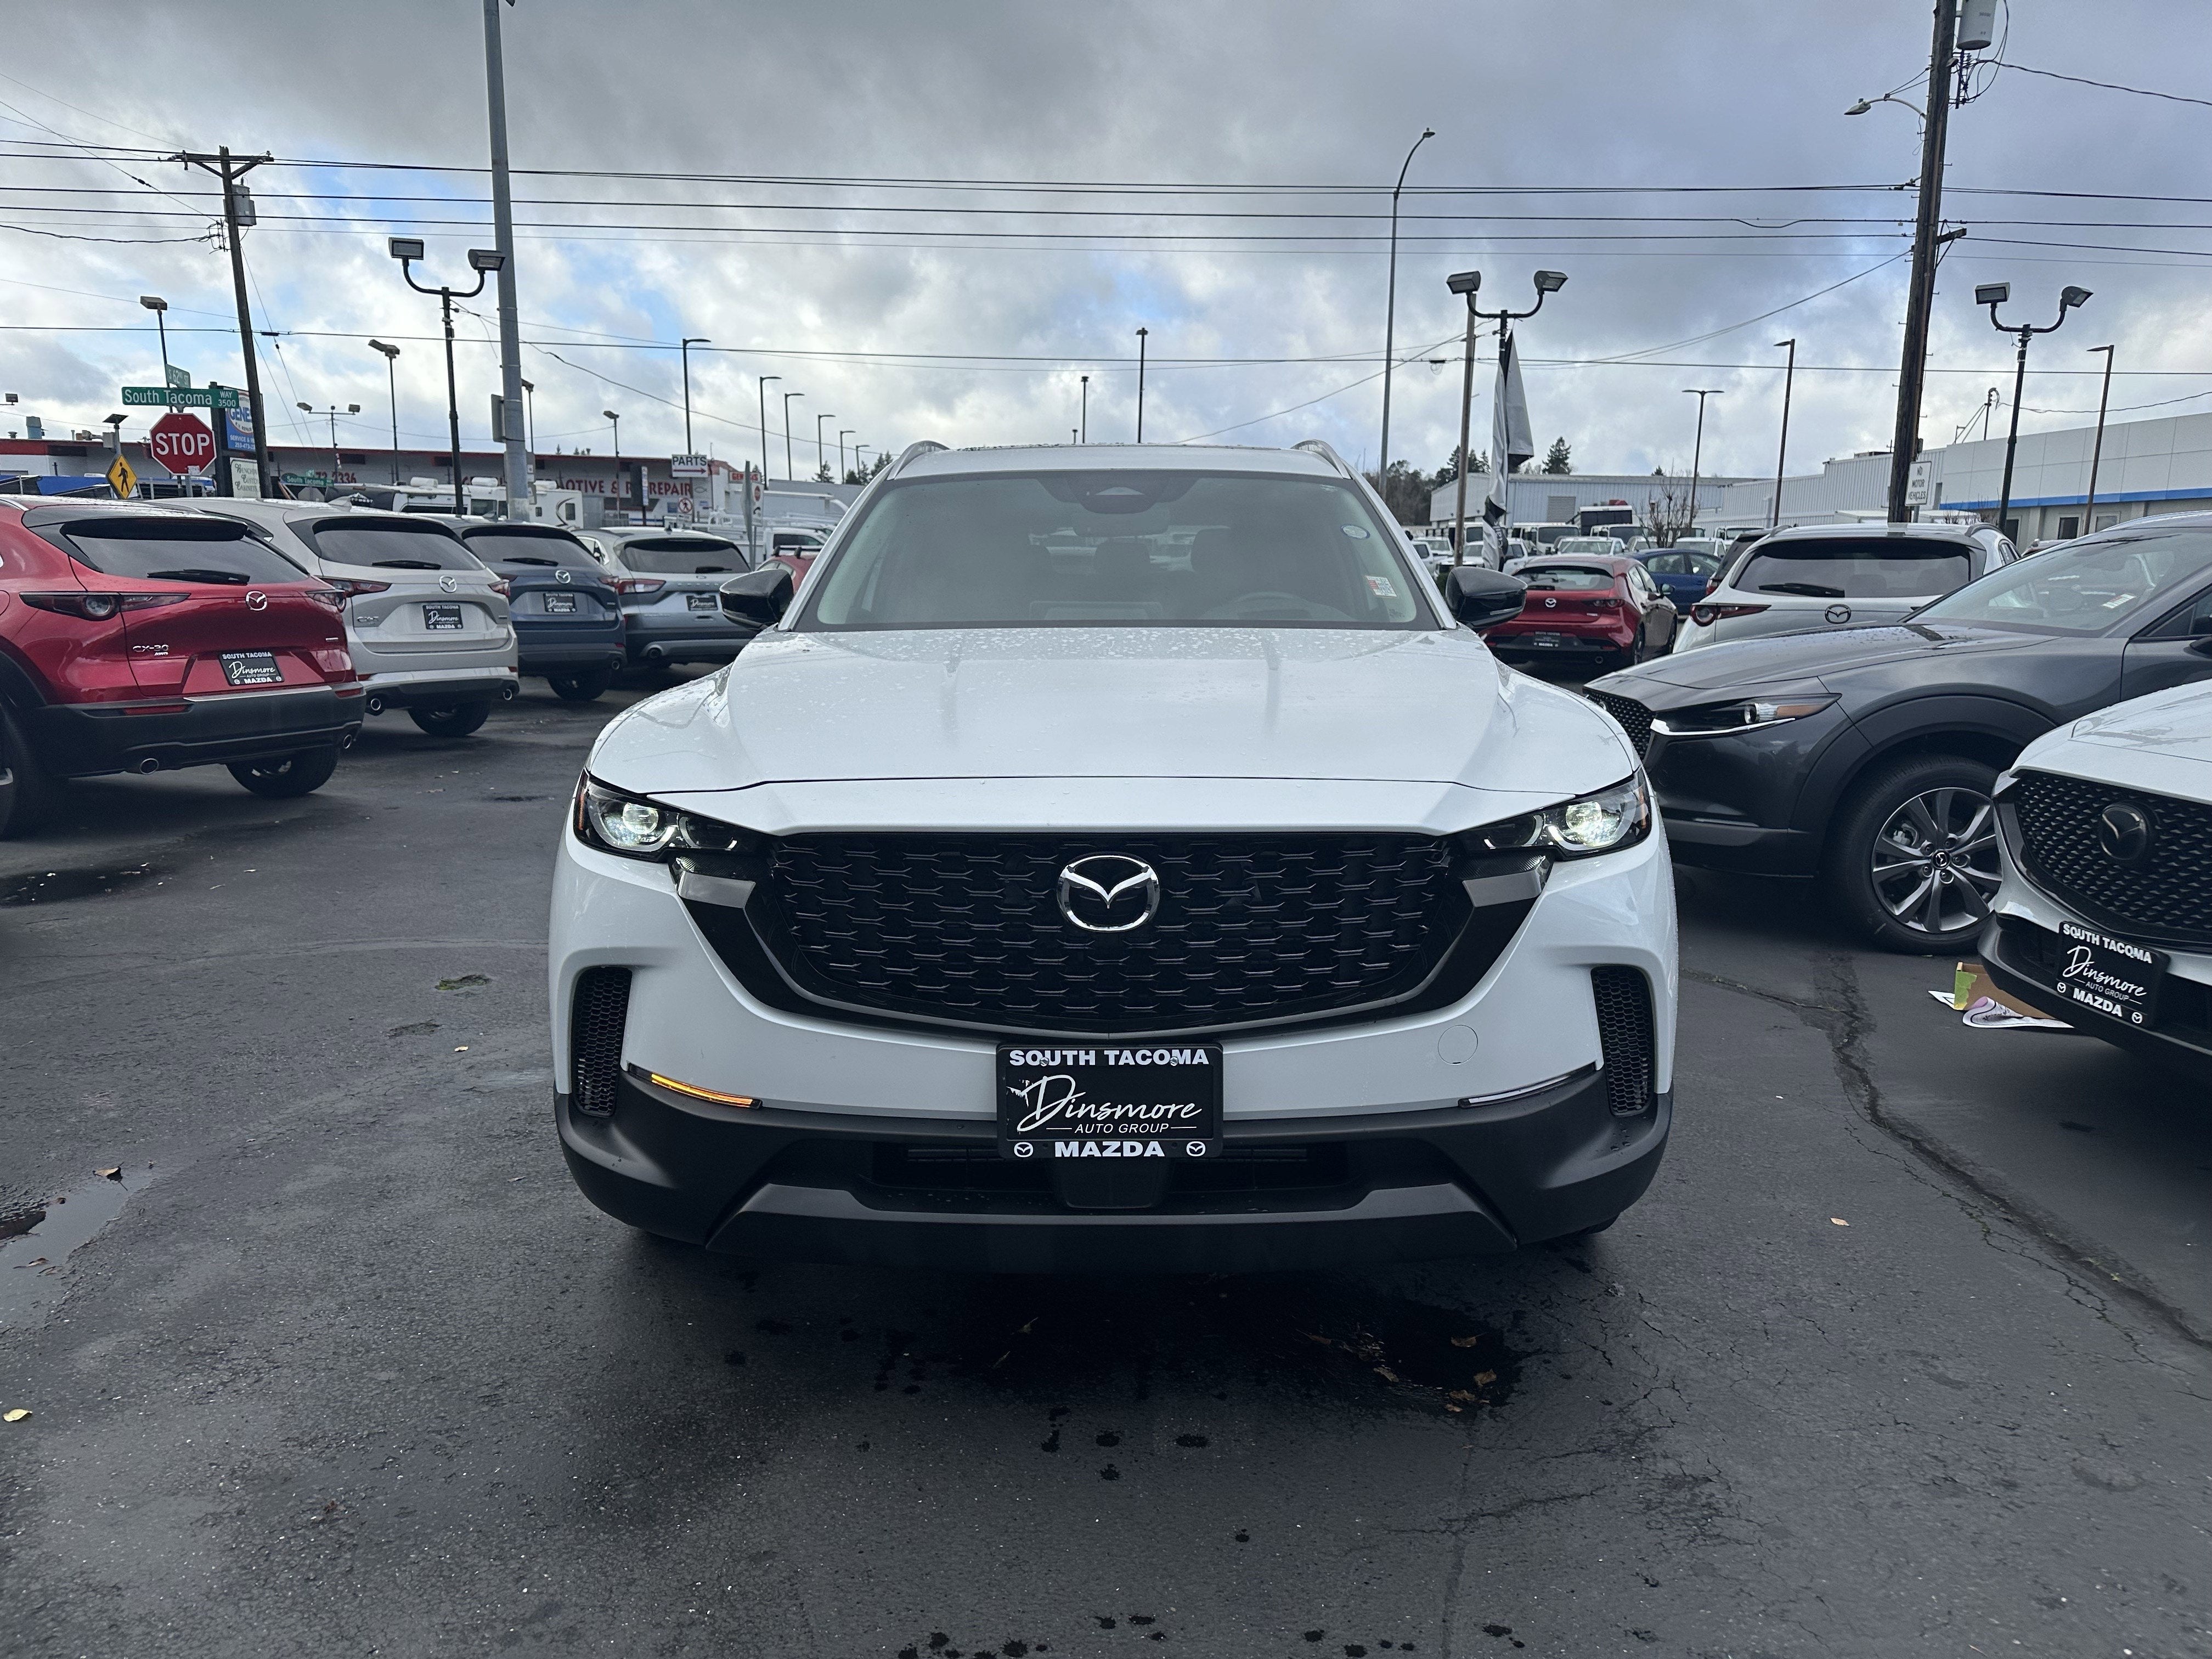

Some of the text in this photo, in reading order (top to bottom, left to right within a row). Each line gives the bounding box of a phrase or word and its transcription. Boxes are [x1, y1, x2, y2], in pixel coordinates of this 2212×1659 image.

[168, 369, 172, 380] S
[184, 375, 189, 385] ST
[125, 390, 212, 405] South Tacoma
[230, 407, 252, 422] GENE
[155, 432, 210, 456] STOP
[672, 456, 707, 466] PARTS
[1917, 465, 1923, 476] NO
[286, 475, 302, 483] South
[1911, 478, 1925, 488] MOTOR
[648, 481, 691, 495] REPAIR
[1908, 491, 1926, 501] VEHICLES
[133, 644, 169, 652] CX-30
[228, 661, 275, 679] Dinsmore
[2063, 924, 2152, 964] SOUTH TACOMA
[2062, 945, 2147, 996] Dinsmore
[2085, 981, 2130, 1001] AUTO GROUP
[2073, 988, 2123, 1017] MAZDA
[1009, 1049, 1209, 1066] SOUTH TACOMA
[1017, 1074, 1203, 1132] Dinsmore
[1074, 1123, 1169, 1134] AUTO GROUP
[1054, 1141, 1165, 1157] MAZDA
